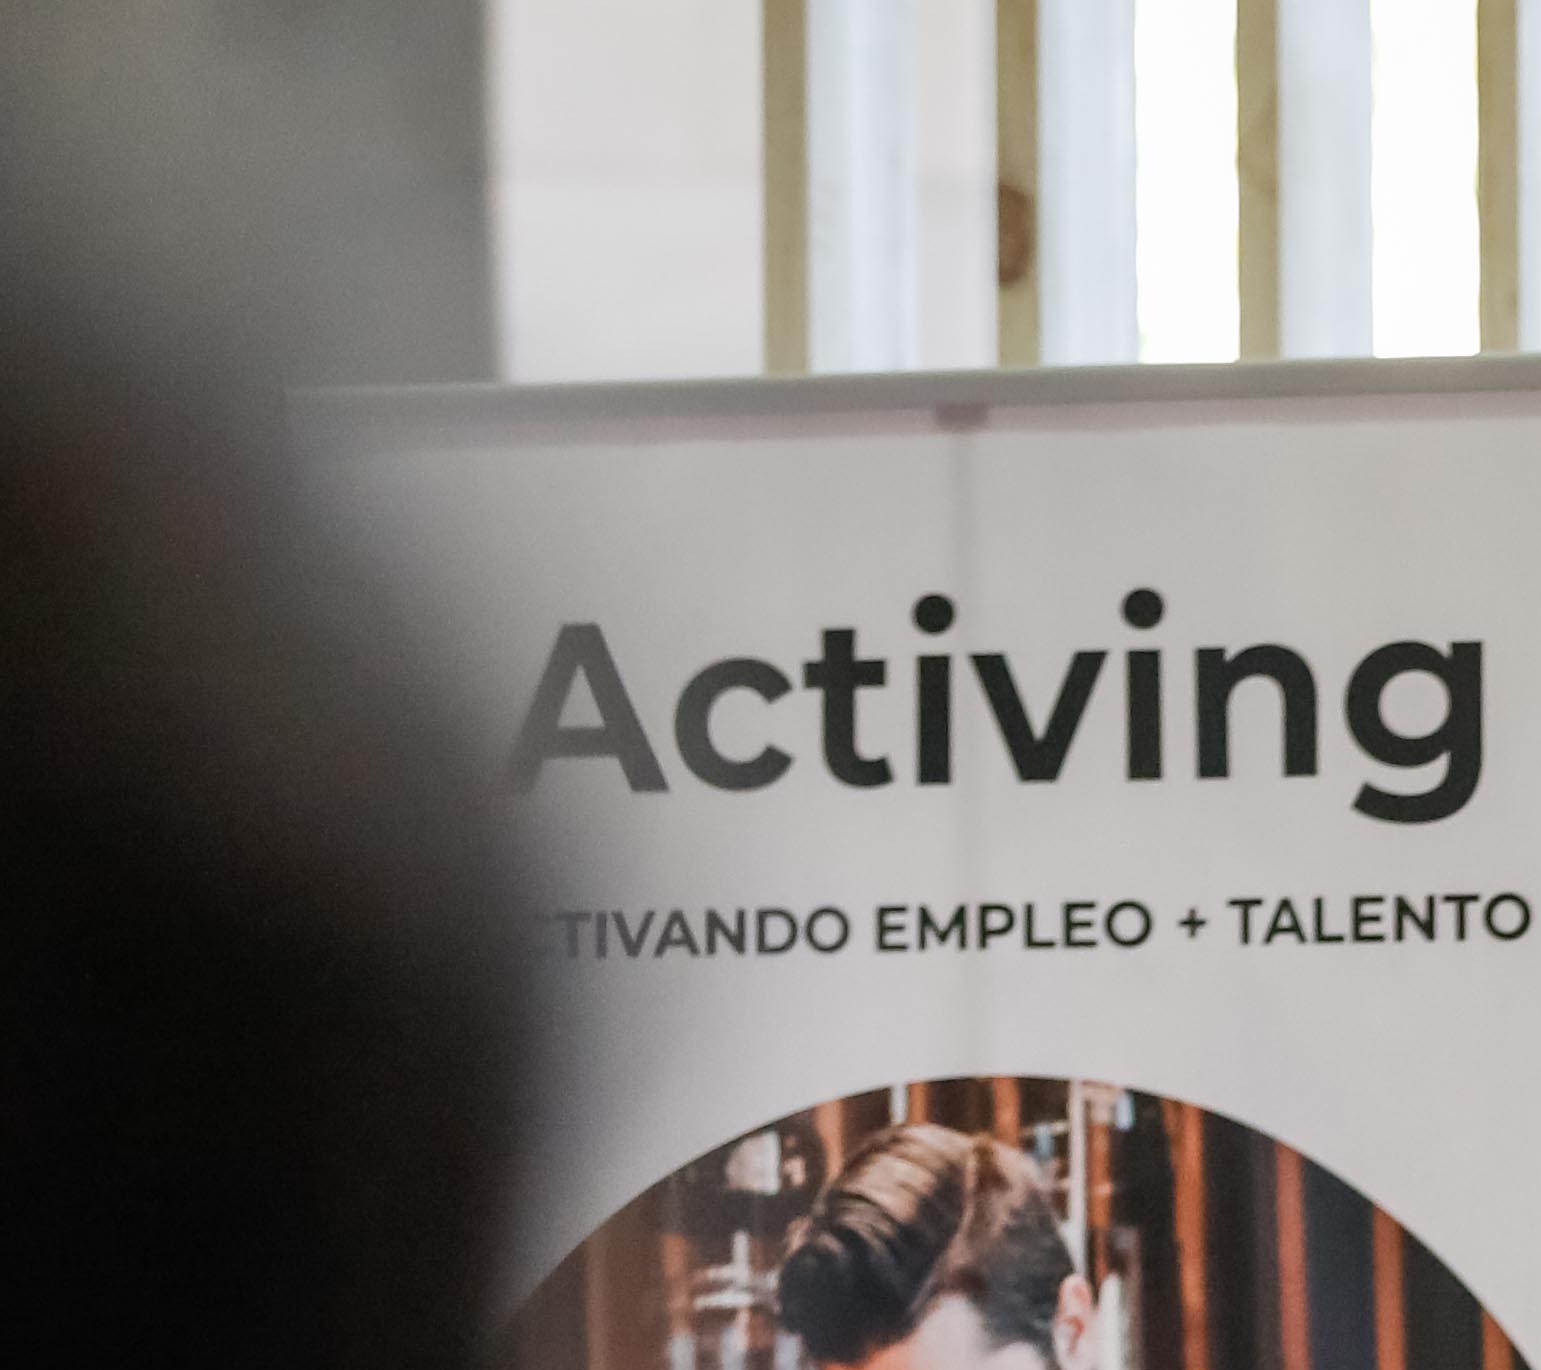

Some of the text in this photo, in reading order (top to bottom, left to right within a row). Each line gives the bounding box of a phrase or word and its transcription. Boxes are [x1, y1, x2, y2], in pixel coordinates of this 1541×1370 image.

[502, 587, 1486, 826] Activing
[540, 906, 849, 960] TIVANDO
[875, 900, 1154, 955] EMPLEO
[1228, 893, 1532, 947] TALENTO
